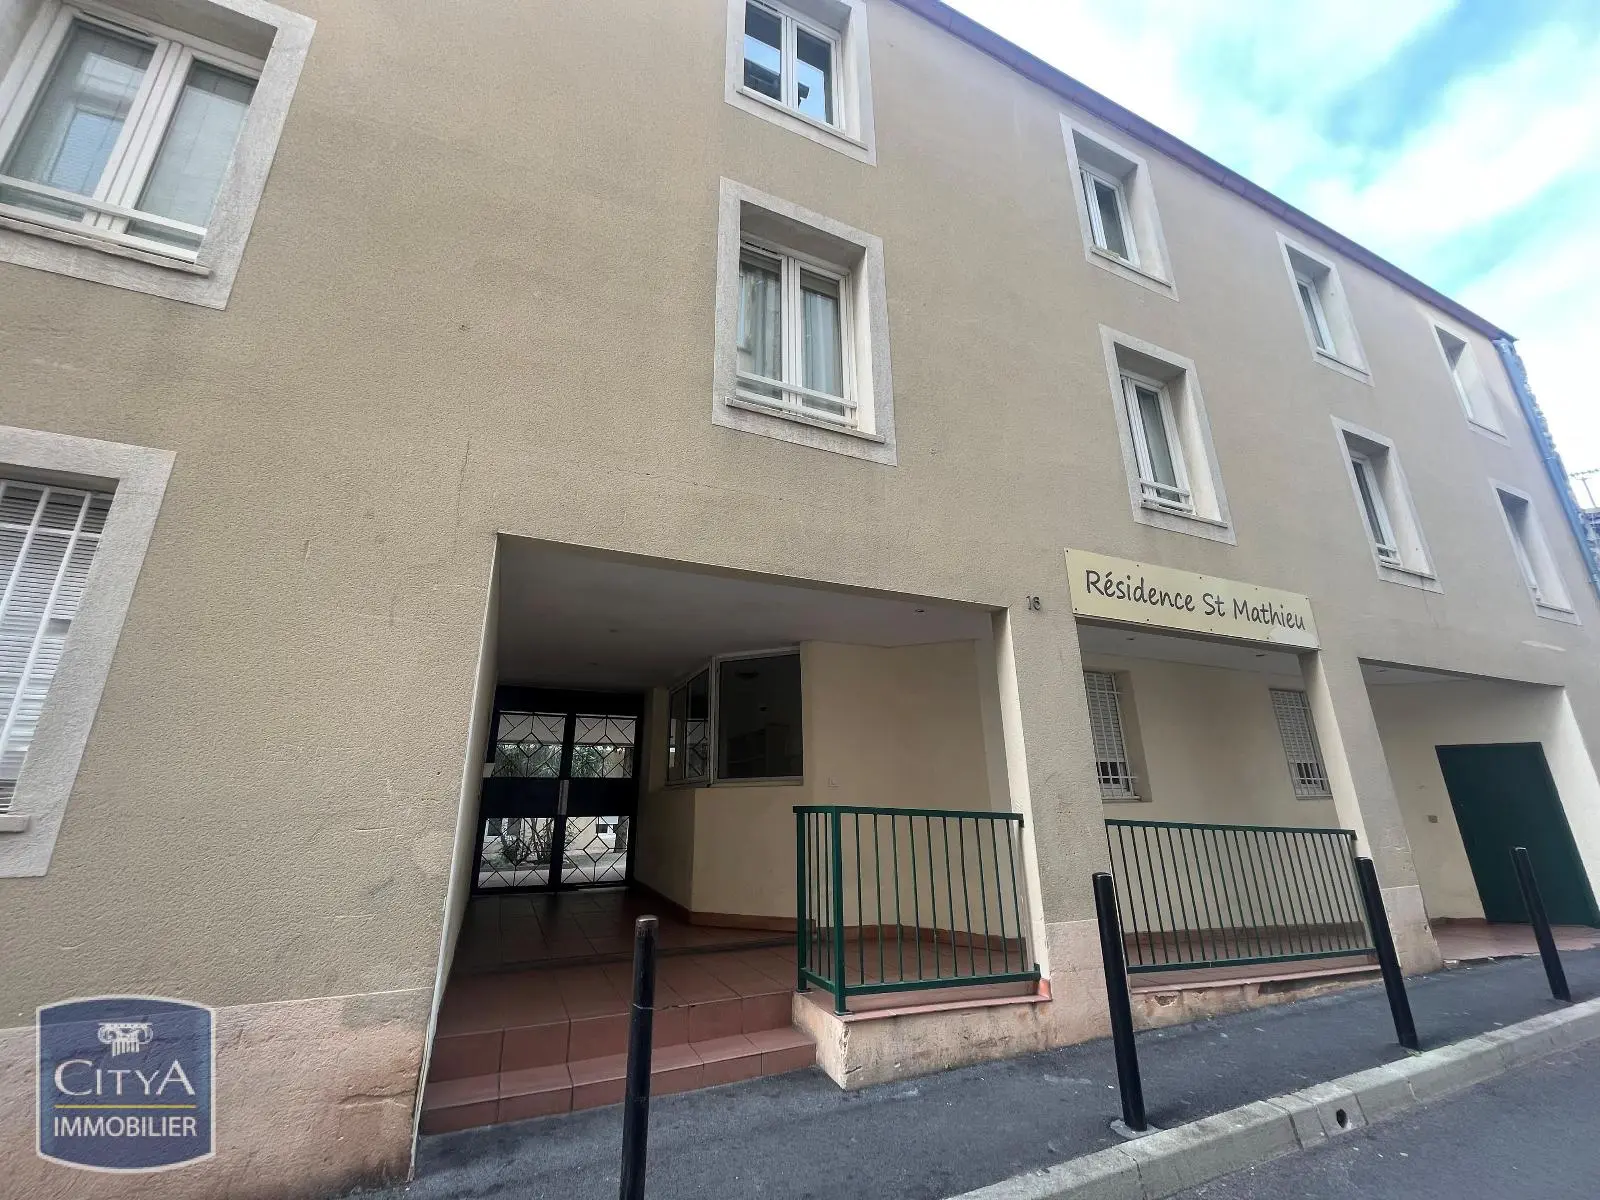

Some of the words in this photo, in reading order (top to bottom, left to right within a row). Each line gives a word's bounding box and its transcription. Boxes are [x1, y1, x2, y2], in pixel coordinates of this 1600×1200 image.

[1025, 595, 1041, 611] 16
[1085, 569, 1196, 612] Résidence
[1203, 593, 1226, 617] St
[1233, 598, 1306, 631] Mathieu
